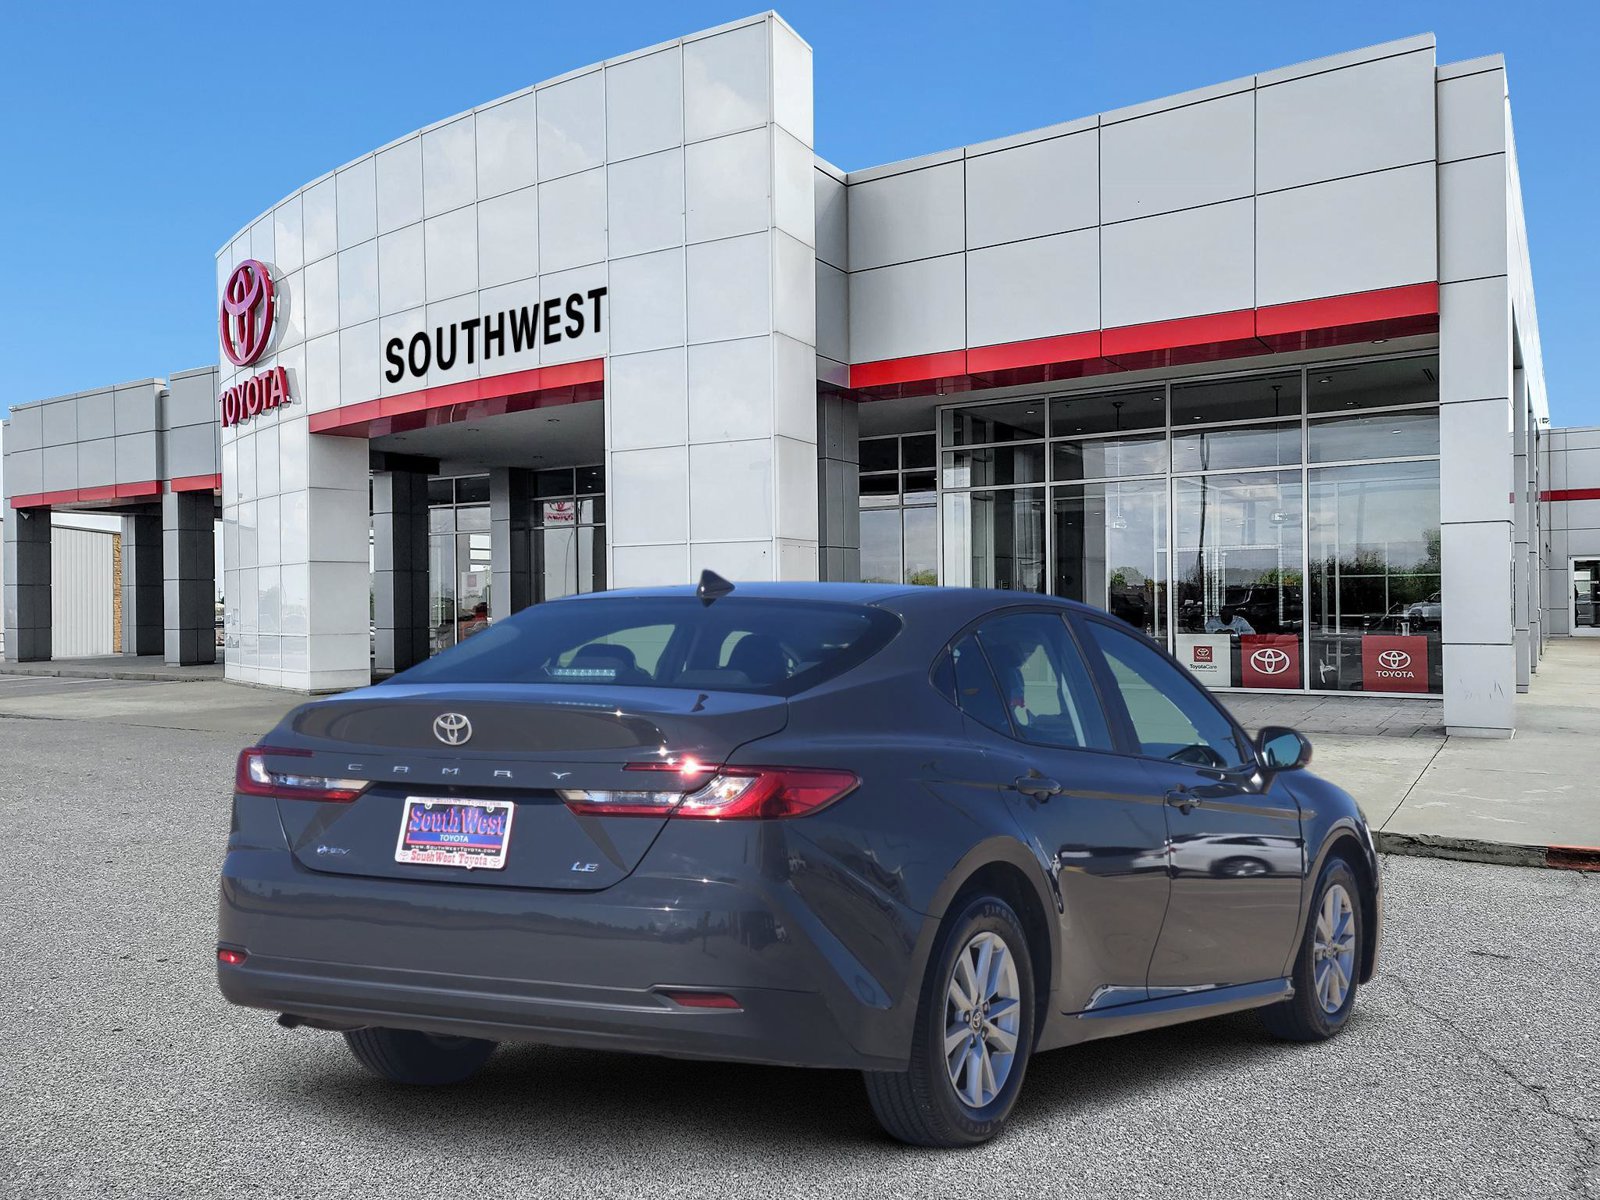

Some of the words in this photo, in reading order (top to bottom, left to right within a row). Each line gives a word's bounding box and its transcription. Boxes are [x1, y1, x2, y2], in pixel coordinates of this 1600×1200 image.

[385, 286, 608, 384] SOUTHWEST
[217, 366, 288, 428] TOYOTA
[1375, 670, 1415, 678] TOYOTA
[347, 763, 572, 780] CAMRY
[439, 834, 469, 843] TOYOTA
[459, 852, 488, 866] Toyota
[570, 861, 599, 872] LE
